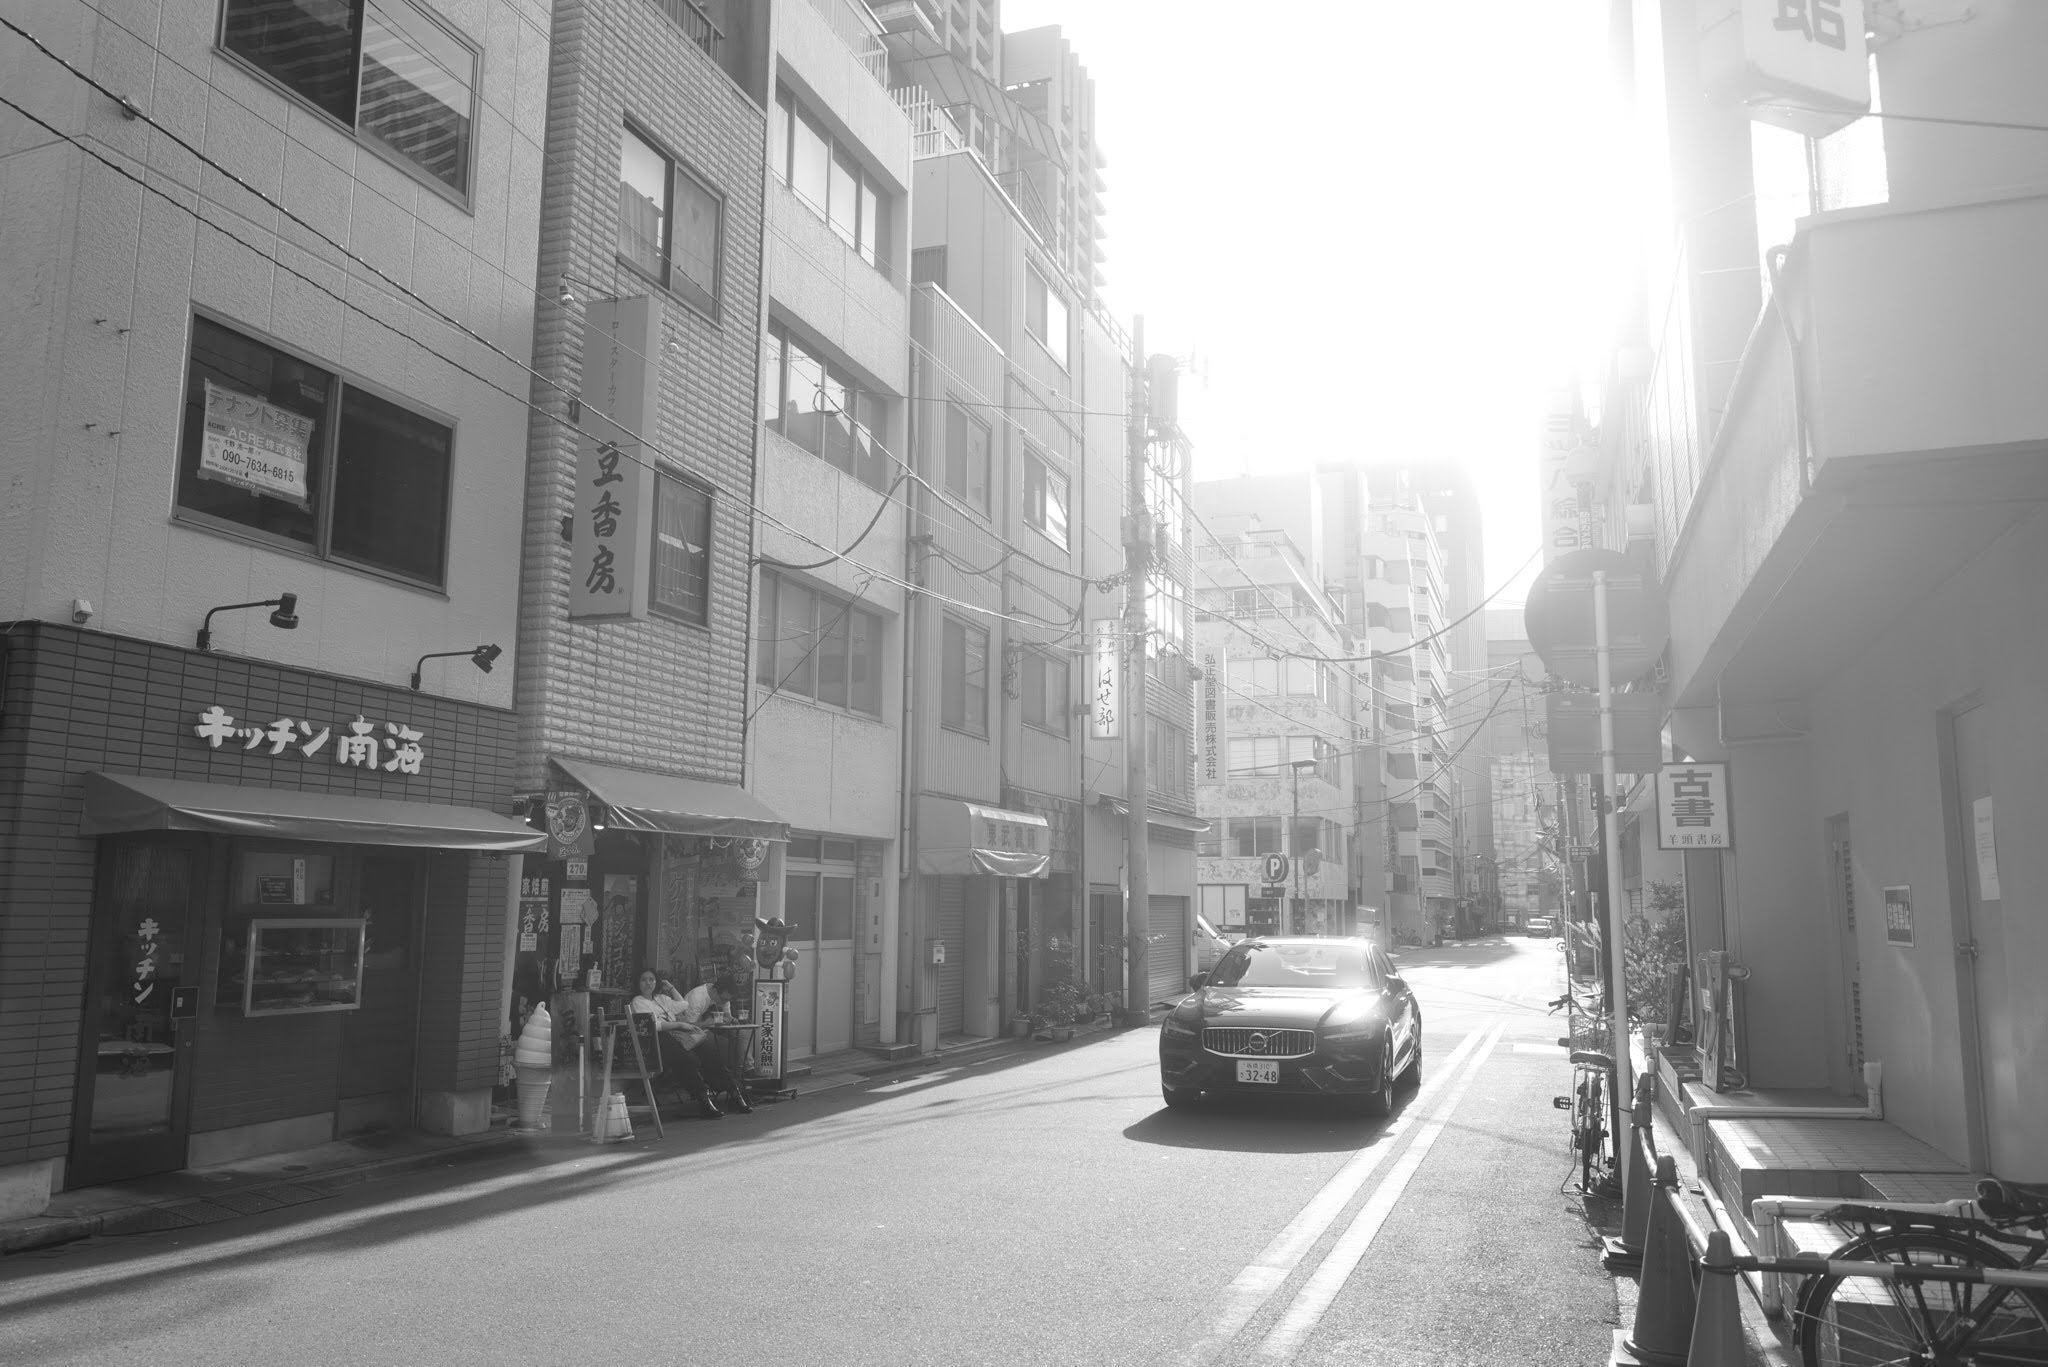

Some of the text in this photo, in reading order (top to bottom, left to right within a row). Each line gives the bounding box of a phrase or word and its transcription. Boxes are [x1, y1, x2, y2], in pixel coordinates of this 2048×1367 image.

[208, 388, 308, 439] テナント募集
[222, 449, 295, 483] 090-7634-6815
[586, 441, 624, 594] 豆香房
[1094, 667, 1115, 735] はせ部
[194, 705, 425, 775] キッチン南海
[1669, 769, 1715, 827] 古書
[1669, 833, 1722, 846] 羊頭書房
[1270, 858, 1281, 877] P
